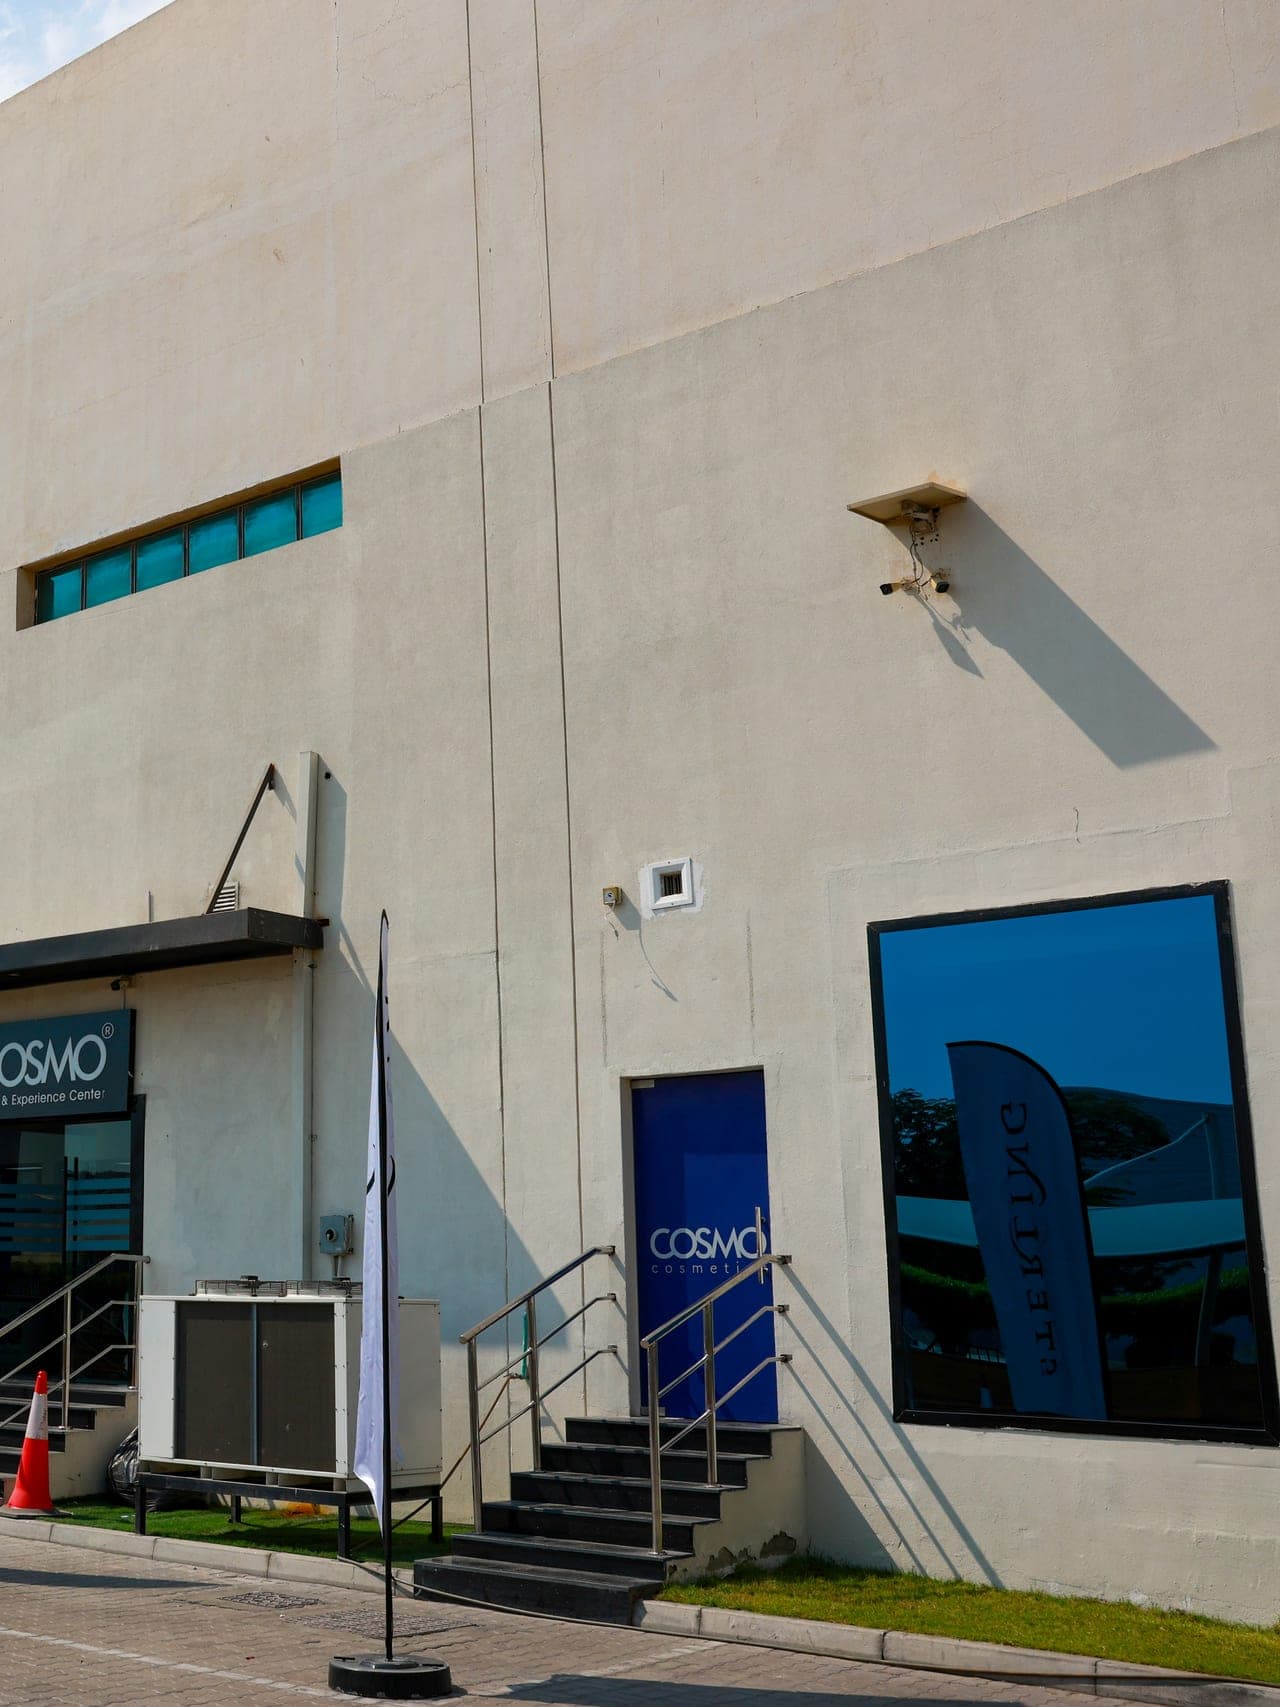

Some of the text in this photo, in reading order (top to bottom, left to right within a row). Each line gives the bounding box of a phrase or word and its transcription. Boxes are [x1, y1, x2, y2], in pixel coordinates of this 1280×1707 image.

[1, 1095, 9, 1106] &
[11, 1090, 66, 1107] Experience
[650, 1226, 767, 1260] COSMO
[651, 1260, 740, 1275] cosmeti
